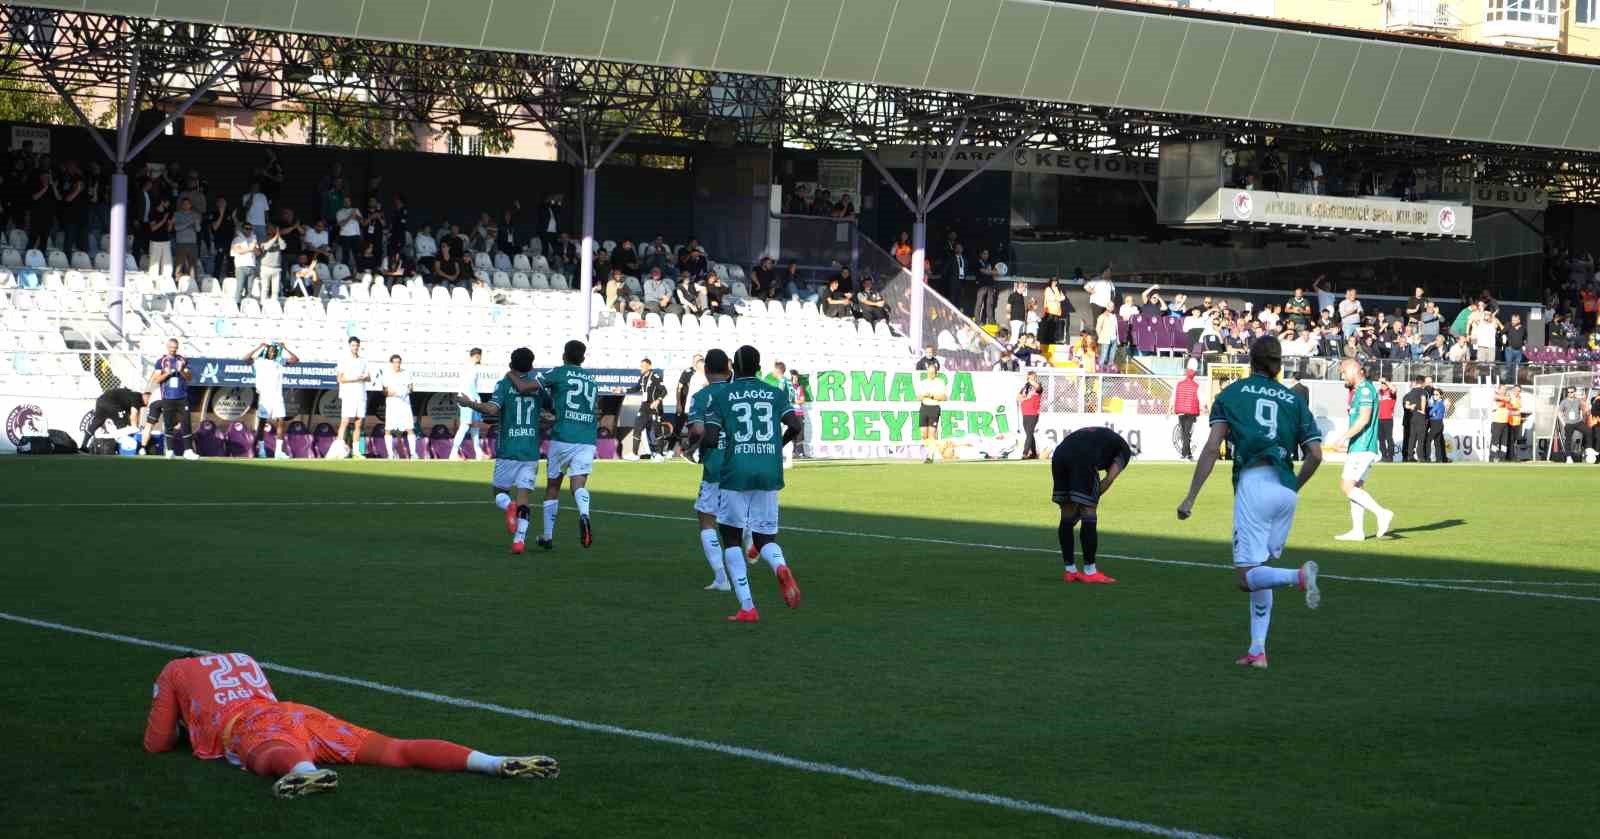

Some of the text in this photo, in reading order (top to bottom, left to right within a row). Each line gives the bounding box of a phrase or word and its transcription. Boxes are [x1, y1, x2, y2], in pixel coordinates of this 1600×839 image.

[566, 379, 597, 411] 24
[728, 389, 774, 401] ALAGÖZ
[1241, 385, 1296, 404] ALAGÖZ
[515, 396, 535, 425] 17
[731, 401, 774, 442] 33
[1254, 398, 1279, 440] 9
